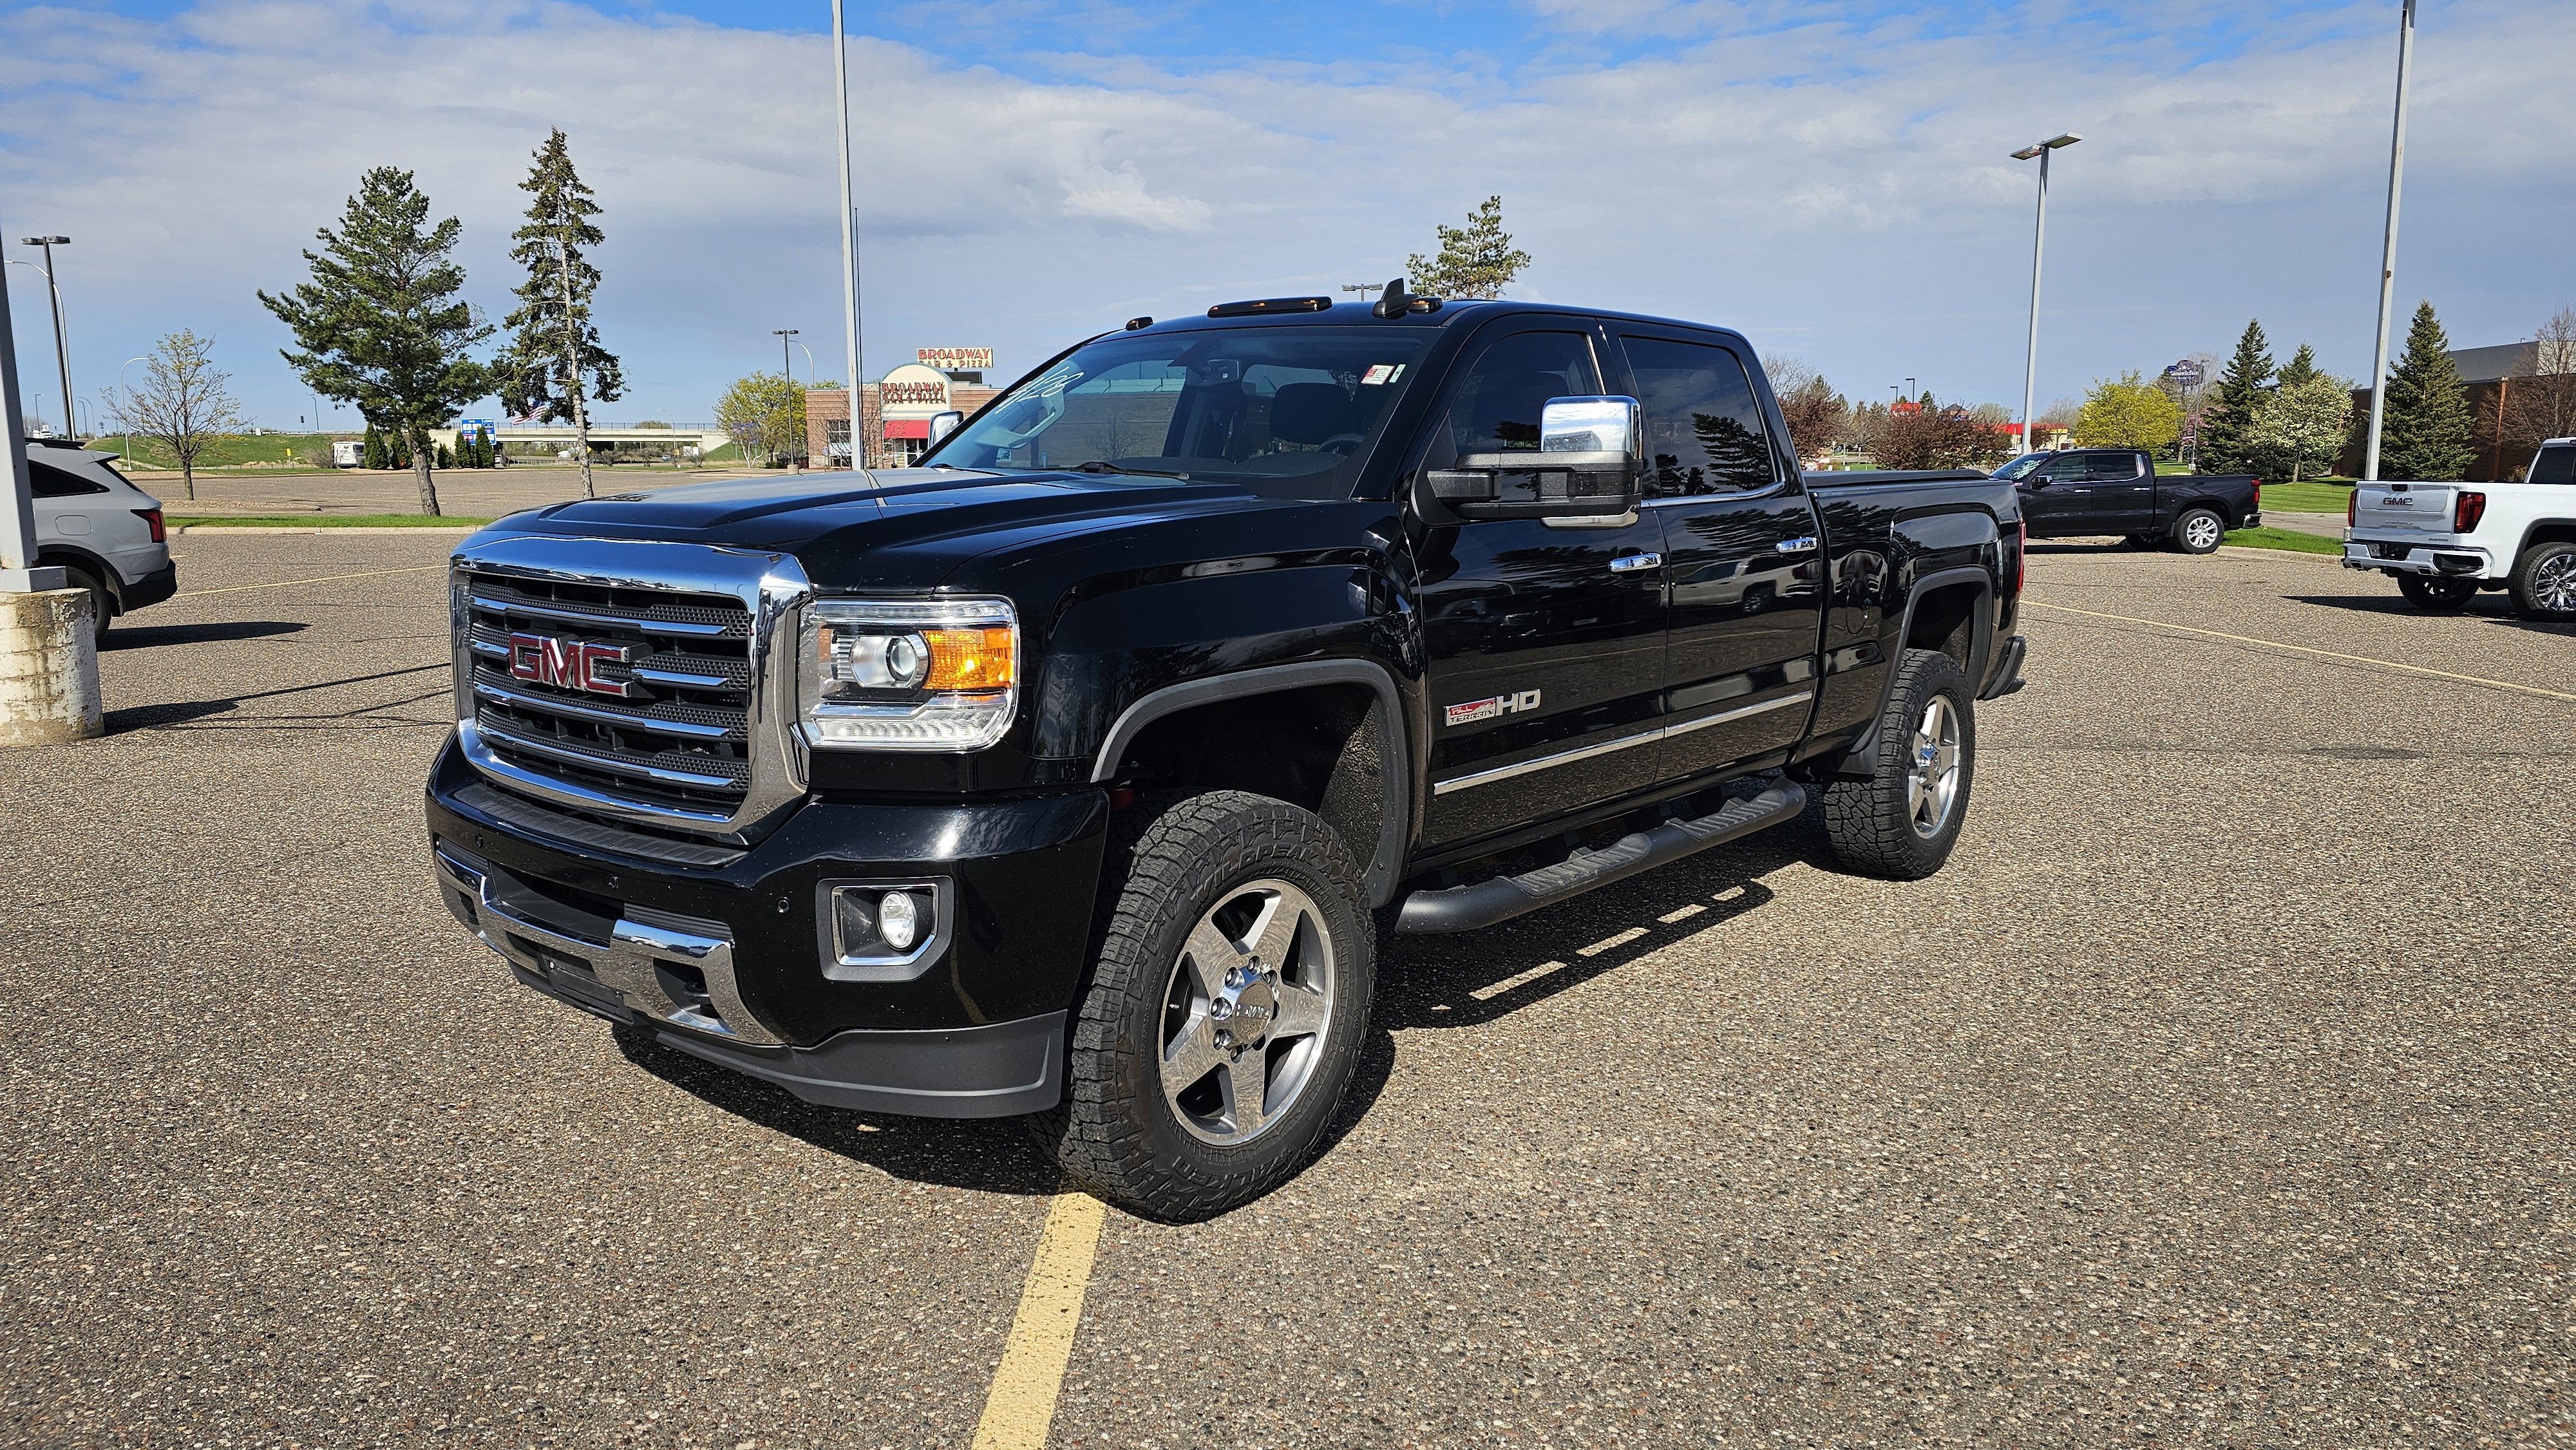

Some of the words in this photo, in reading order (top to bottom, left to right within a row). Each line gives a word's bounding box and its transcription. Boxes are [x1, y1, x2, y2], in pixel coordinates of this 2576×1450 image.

[918, 348, 990, 359] BROADWAY
[882, 382, 945, 393] BROADWAY
[509, 632, 630, 697] GMC
[1495, 688, 1541, 716] HD
[1450, 710, 1494, 723] TERRAIN
[1452, 706, 1473, 715] ALL
[1189, 843, 1320, 908] WILDPEAK
